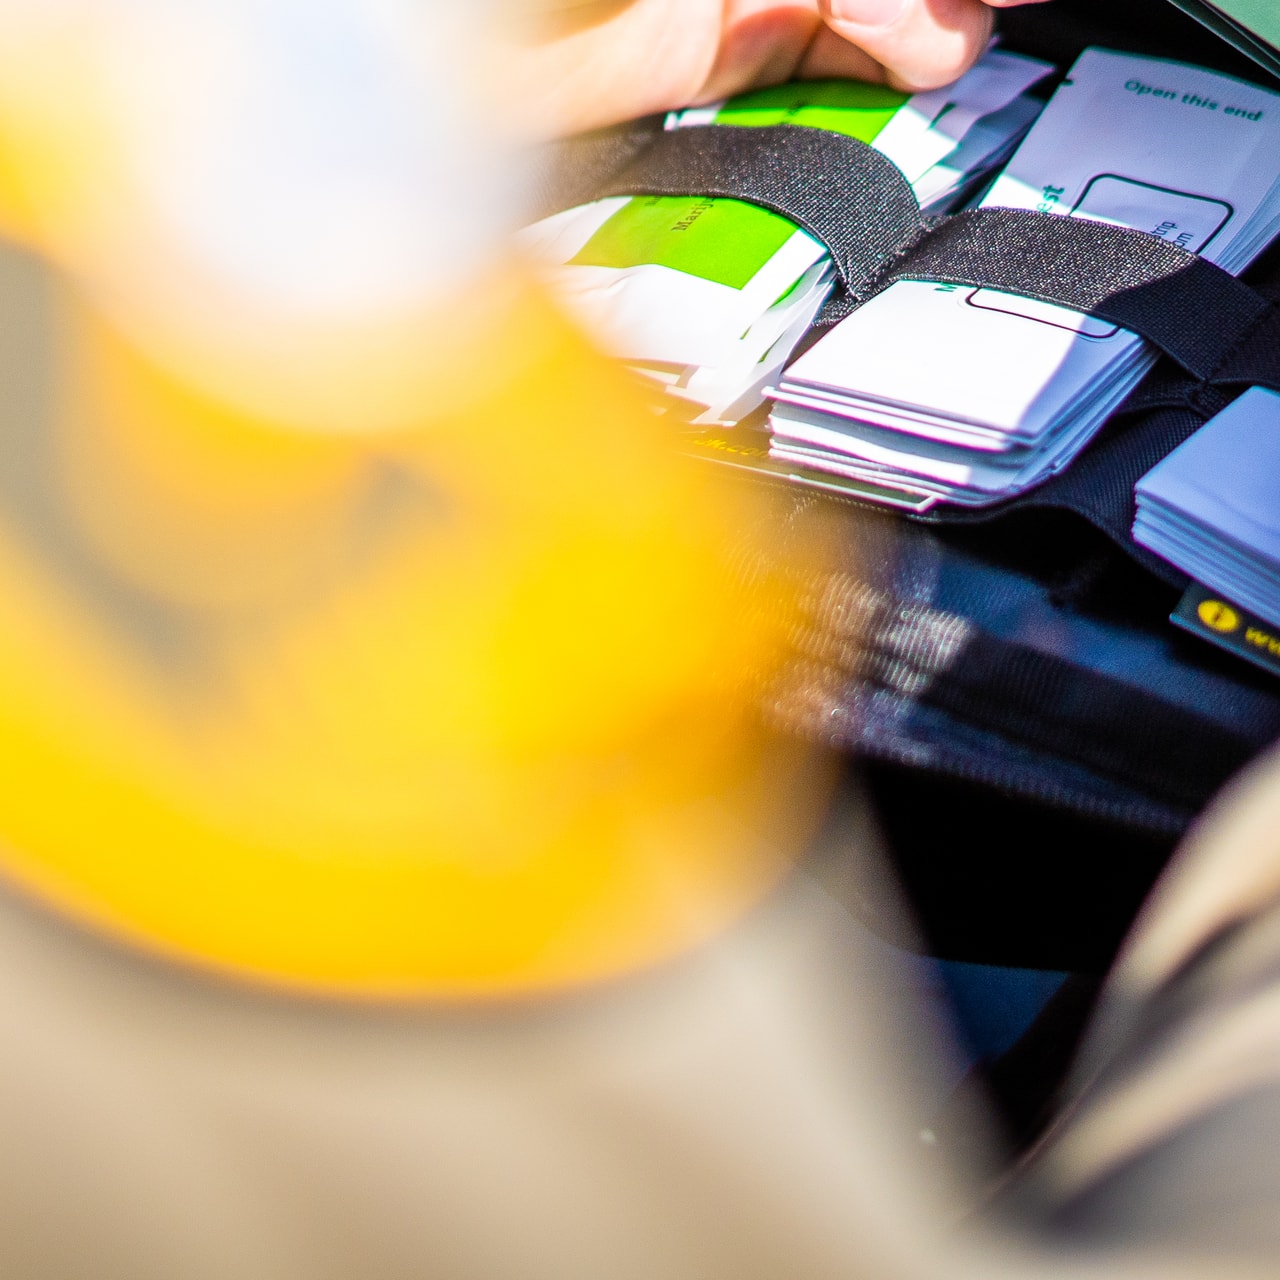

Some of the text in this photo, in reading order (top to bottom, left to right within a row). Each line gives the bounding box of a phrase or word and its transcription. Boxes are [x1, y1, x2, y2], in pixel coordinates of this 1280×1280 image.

[1124, 78, 1264, 122] Open this end
